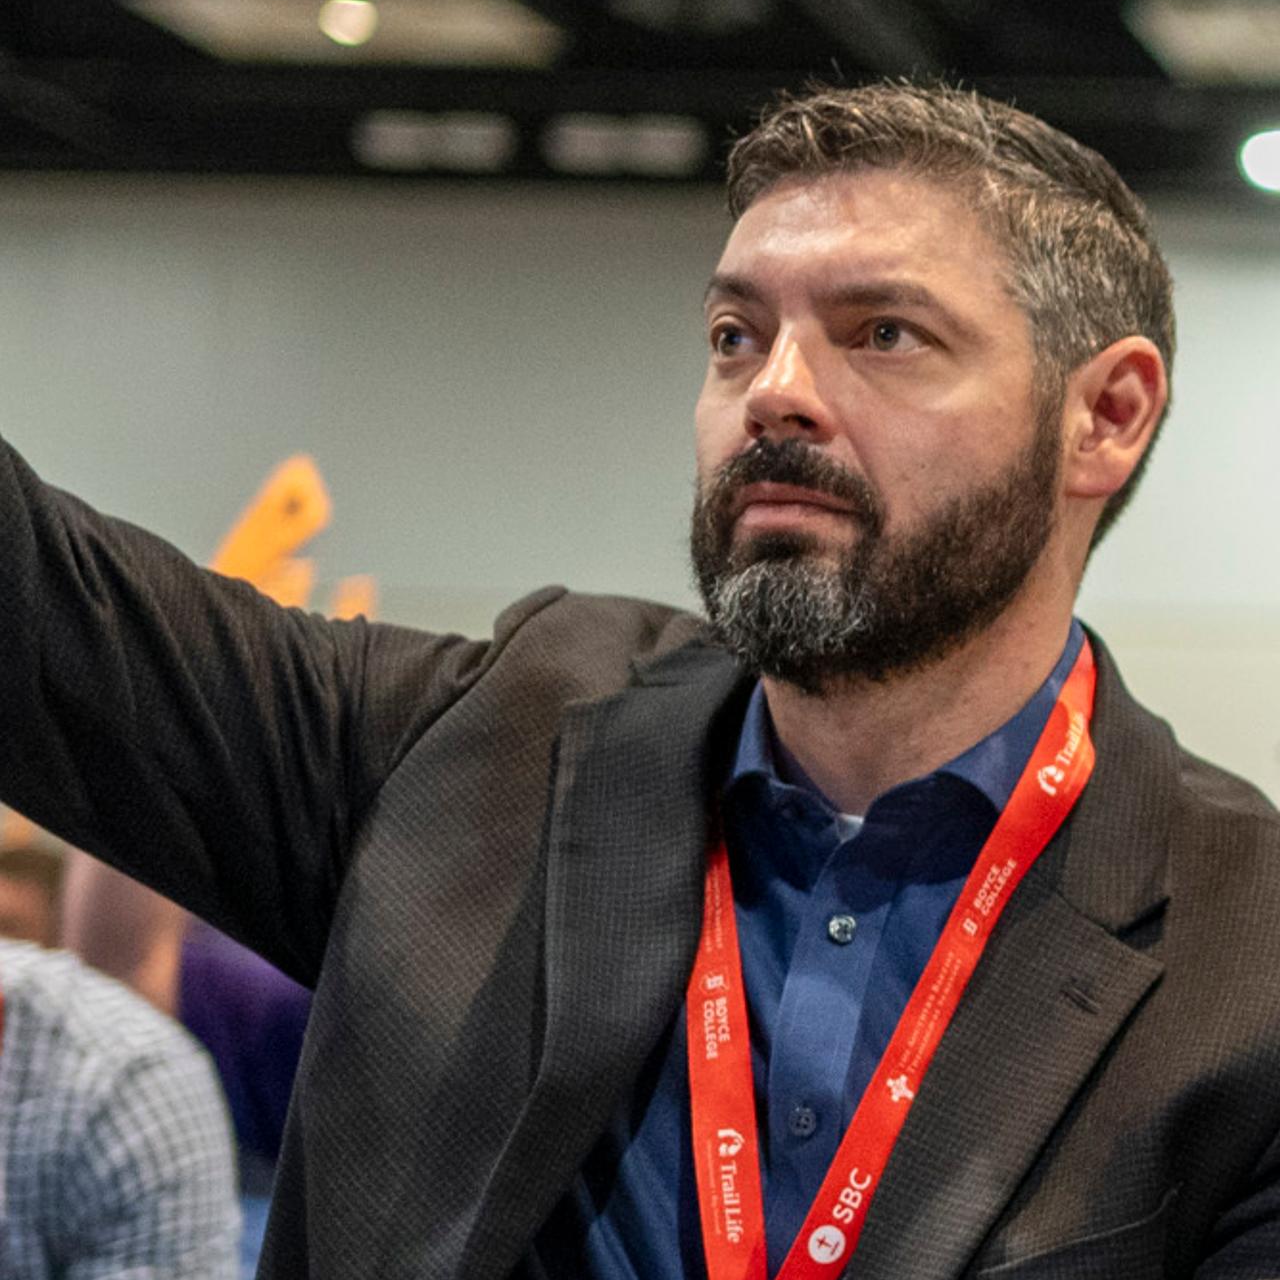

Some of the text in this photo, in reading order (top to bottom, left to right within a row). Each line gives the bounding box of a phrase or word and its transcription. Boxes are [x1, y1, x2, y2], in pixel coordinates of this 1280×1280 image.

[973, 864, 1000, 909] BOYCE
[980, 858, 1017, 916] COLLEGE
[704, 999, 719, 1061] COLLEGE
[715, 996, 731, 1043] BOYCE
[721, 1160, 744, 1243] Trail Life
[832, 1168, 871, 1223] SBC
